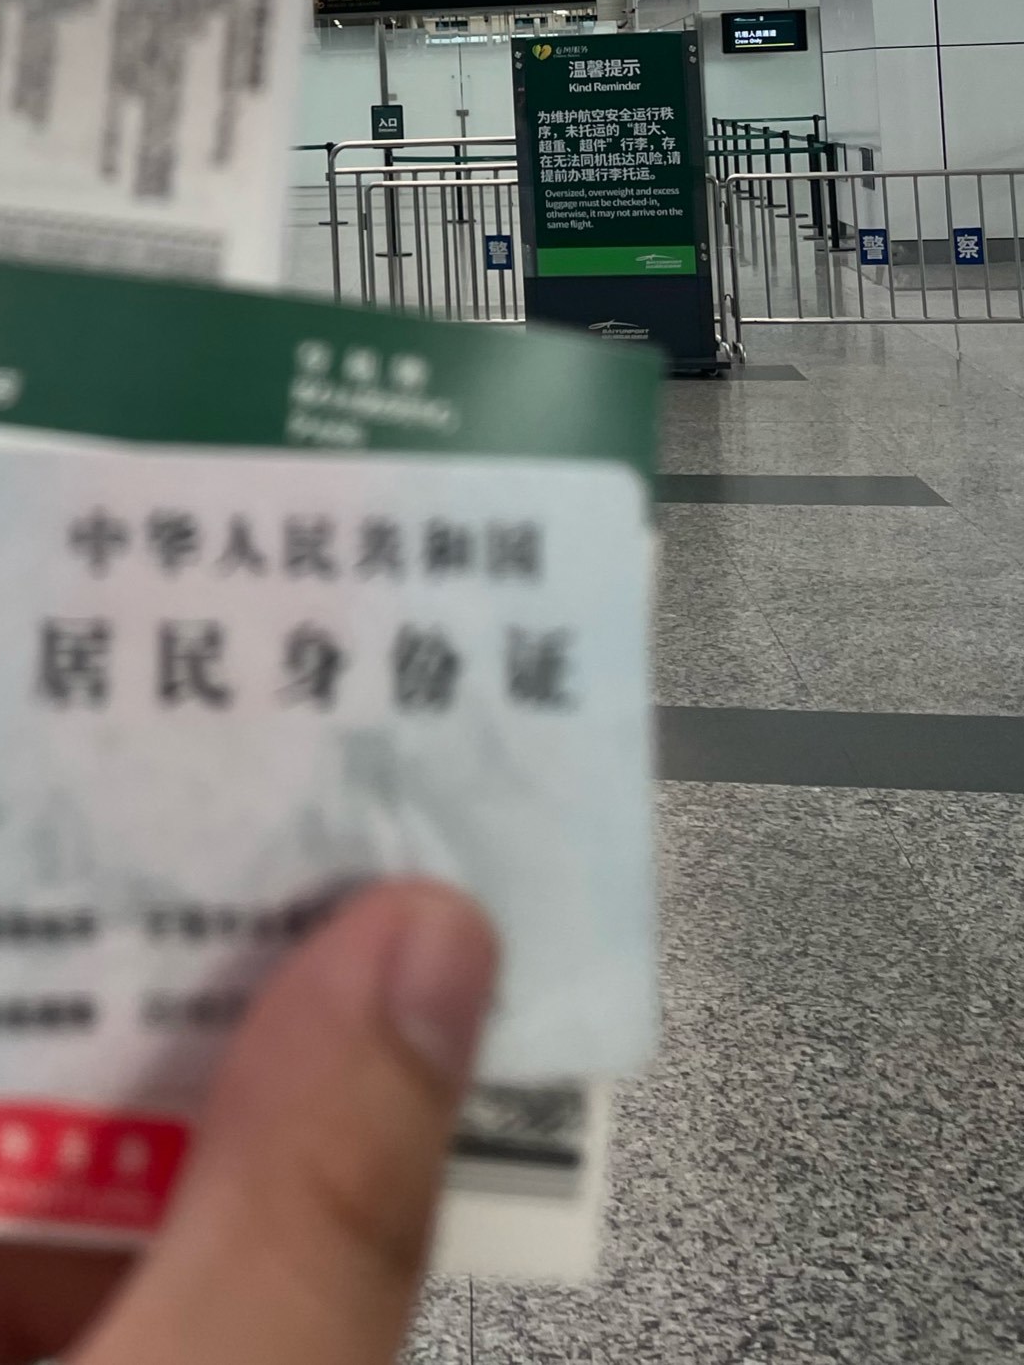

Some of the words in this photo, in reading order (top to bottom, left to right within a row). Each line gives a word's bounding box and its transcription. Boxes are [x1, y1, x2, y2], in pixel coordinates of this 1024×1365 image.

[568, 59, 641, 79] 温馨提示
[569, 82, 592, 93] Kind
[594, 81, 641, 92] Reminder
[379, 118, 397, 127] 入口
[537, 107, 674, 124] 为维护航空安全运行秩
[541, 167, 656, 183] 提前办理行李托运。
[545, 189, 587, 198] Oversized,
[588, 188, 634, 199] overweight
[635, 187, 651, 195] and
[545, 200, 578, 210] luggage
[601, 198, 612, 207] be
[612, 197, 660, 207] checked-in,
[546, 210, 589, 219] otherwise,
[597, 210, 615, 219] may
[616, 209, 630, 217] not
[669, 208, 683, 216] the
[570, 220, 594, 230] flight.
[488, 240, 508, 265] 警
[863, 235, 885, 260] 警
[957, 234, 979, 259] 察
[68, 501, 550, 585] 中华人民共和国
[35, 615, 581, 715] 居民身份证
